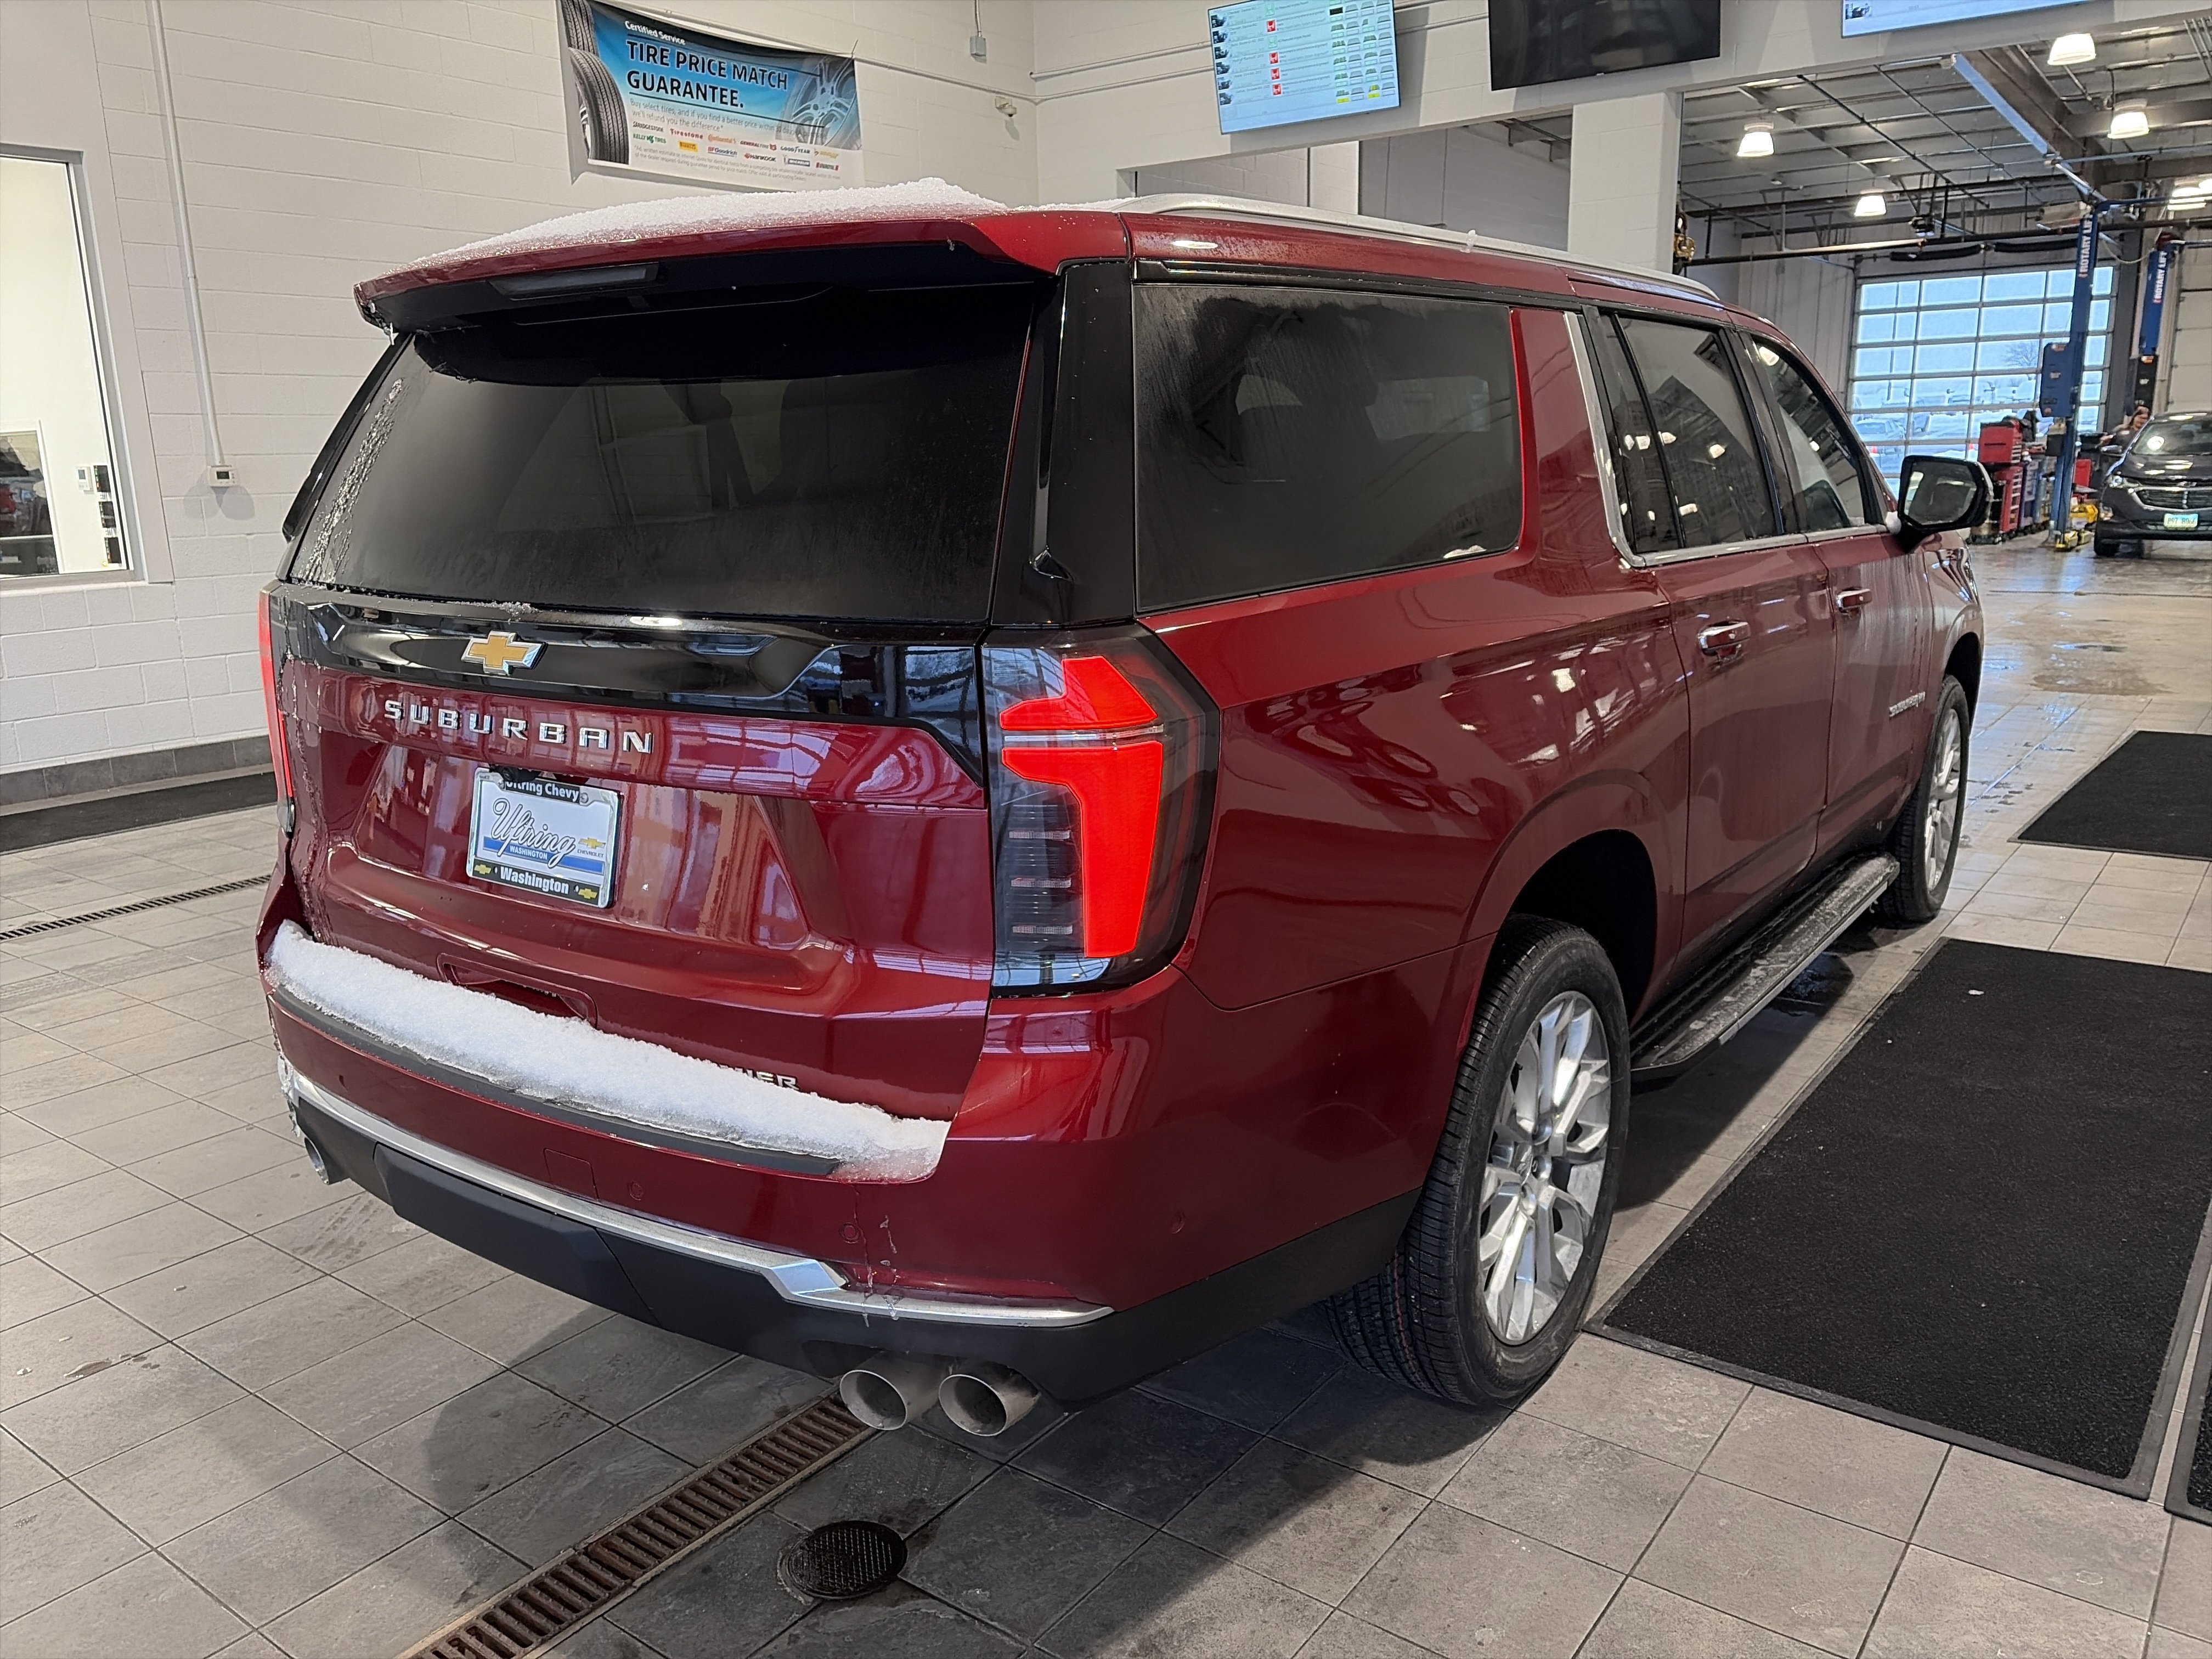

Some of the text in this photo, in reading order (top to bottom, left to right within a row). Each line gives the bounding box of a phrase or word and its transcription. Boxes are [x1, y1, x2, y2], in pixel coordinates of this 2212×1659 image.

[625, 20, 686, 46] Certified Service
[627, 41, 788, 90] TIRE PRICE MATCH
[627, 70, 744, 108] GUARANTEE.
[630, 98, 641, 108] Buy
[642, 101, 659, 110] select
[678, 109, 689, 117] and
[709, 112, 721, 122] find
[679, 119, 690, 127] the
[670, 128, 703, 139] Firestone
[708, 146, 737, 156] BFGoodrich
[2079, 236, 2091, 273] ROTARY
[2154, 269, 2165, 299] ROTARY
[385, 700, 653, 754] SUBURBAN
[545, 783, 579, 802] Chevy
[491, 798, 576, 869] Uftring
[510, 845, 548, 861] WASHINGTON
[577, 849, 604, 858] CHEVROLET
[500, 866, 569, 895] Washington
